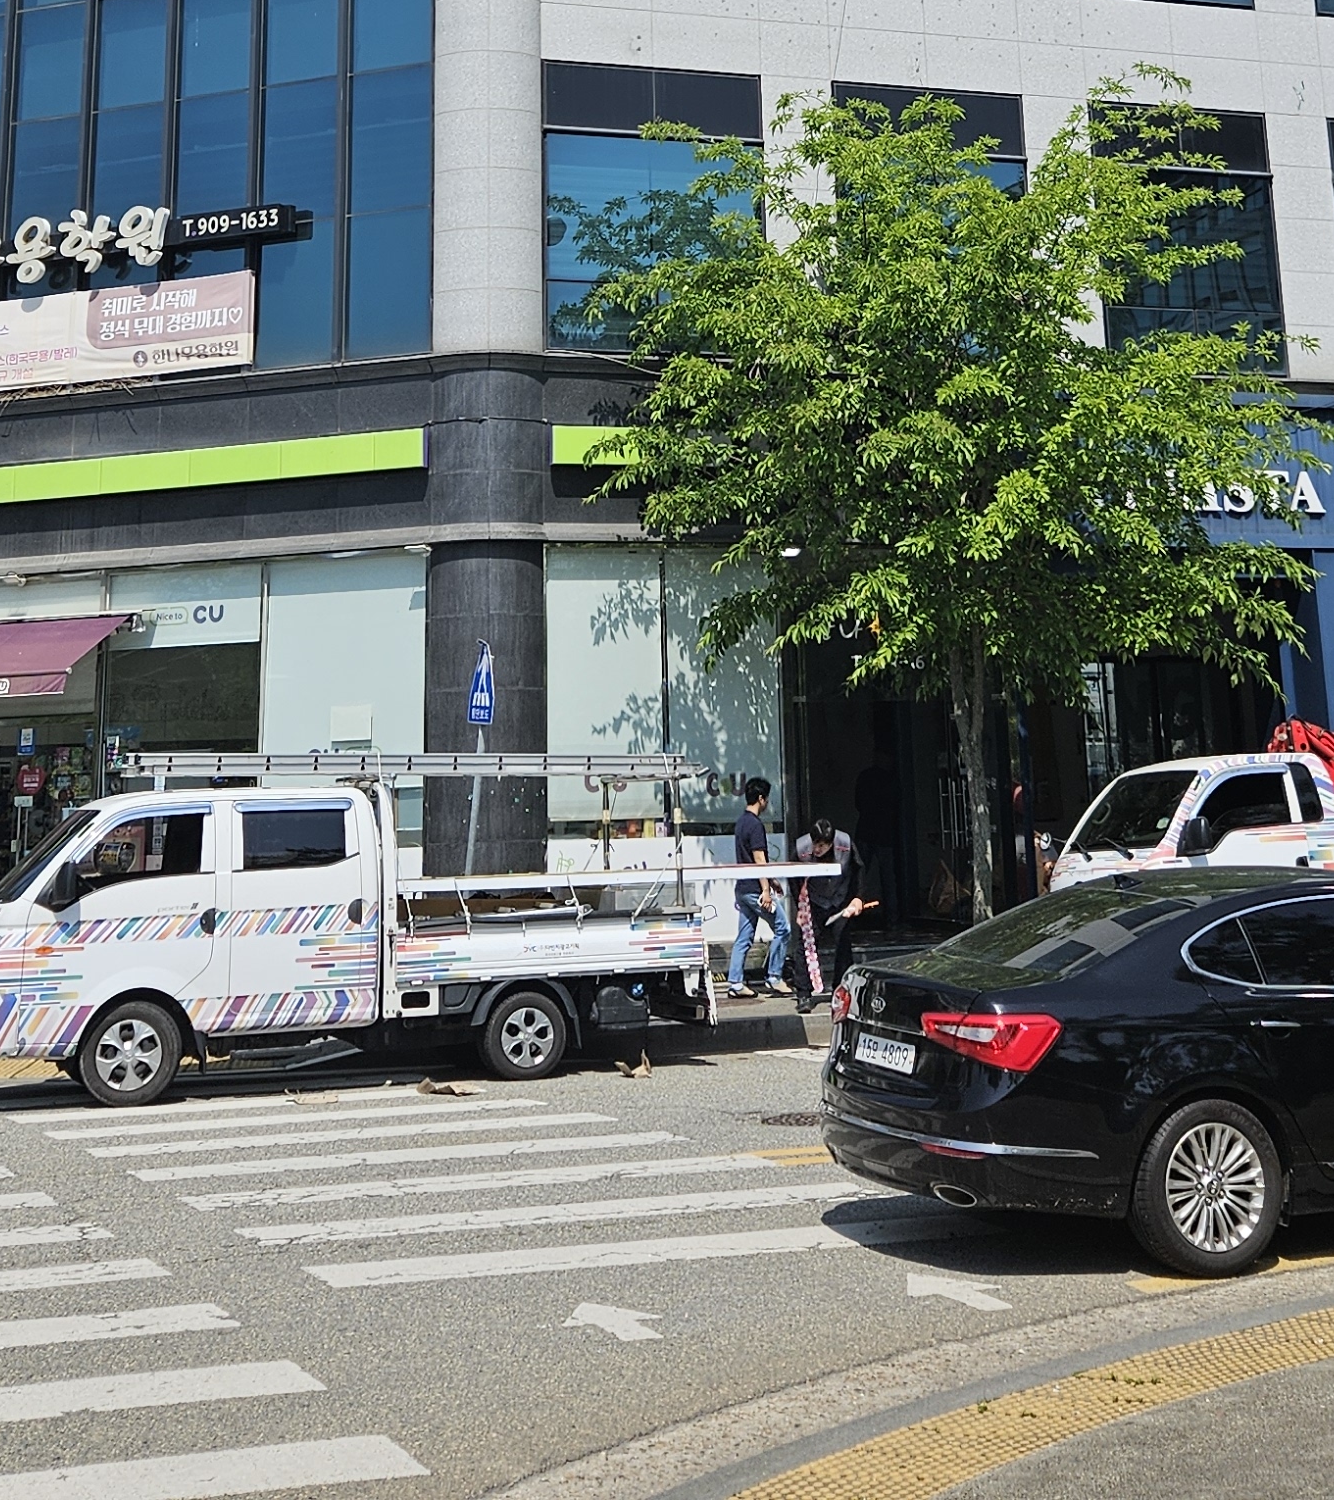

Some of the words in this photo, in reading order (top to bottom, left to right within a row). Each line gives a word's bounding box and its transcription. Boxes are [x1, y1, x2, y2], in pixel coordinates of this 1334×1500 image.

[181, 208, 280, 239] T.909-1633
[101, 294, 147, 318] 취미로
[149, 288, 197, 312] 시작해
[99, 320, 130, 341] 정식
[133, 315, 164, 336] 무대
[152, 340, 239, 365] 한나무용학원
[156, 613, 173, 621] Nice
[193, 605, 224, 624] CU
[881, 1043, 909, 1068] 4809
